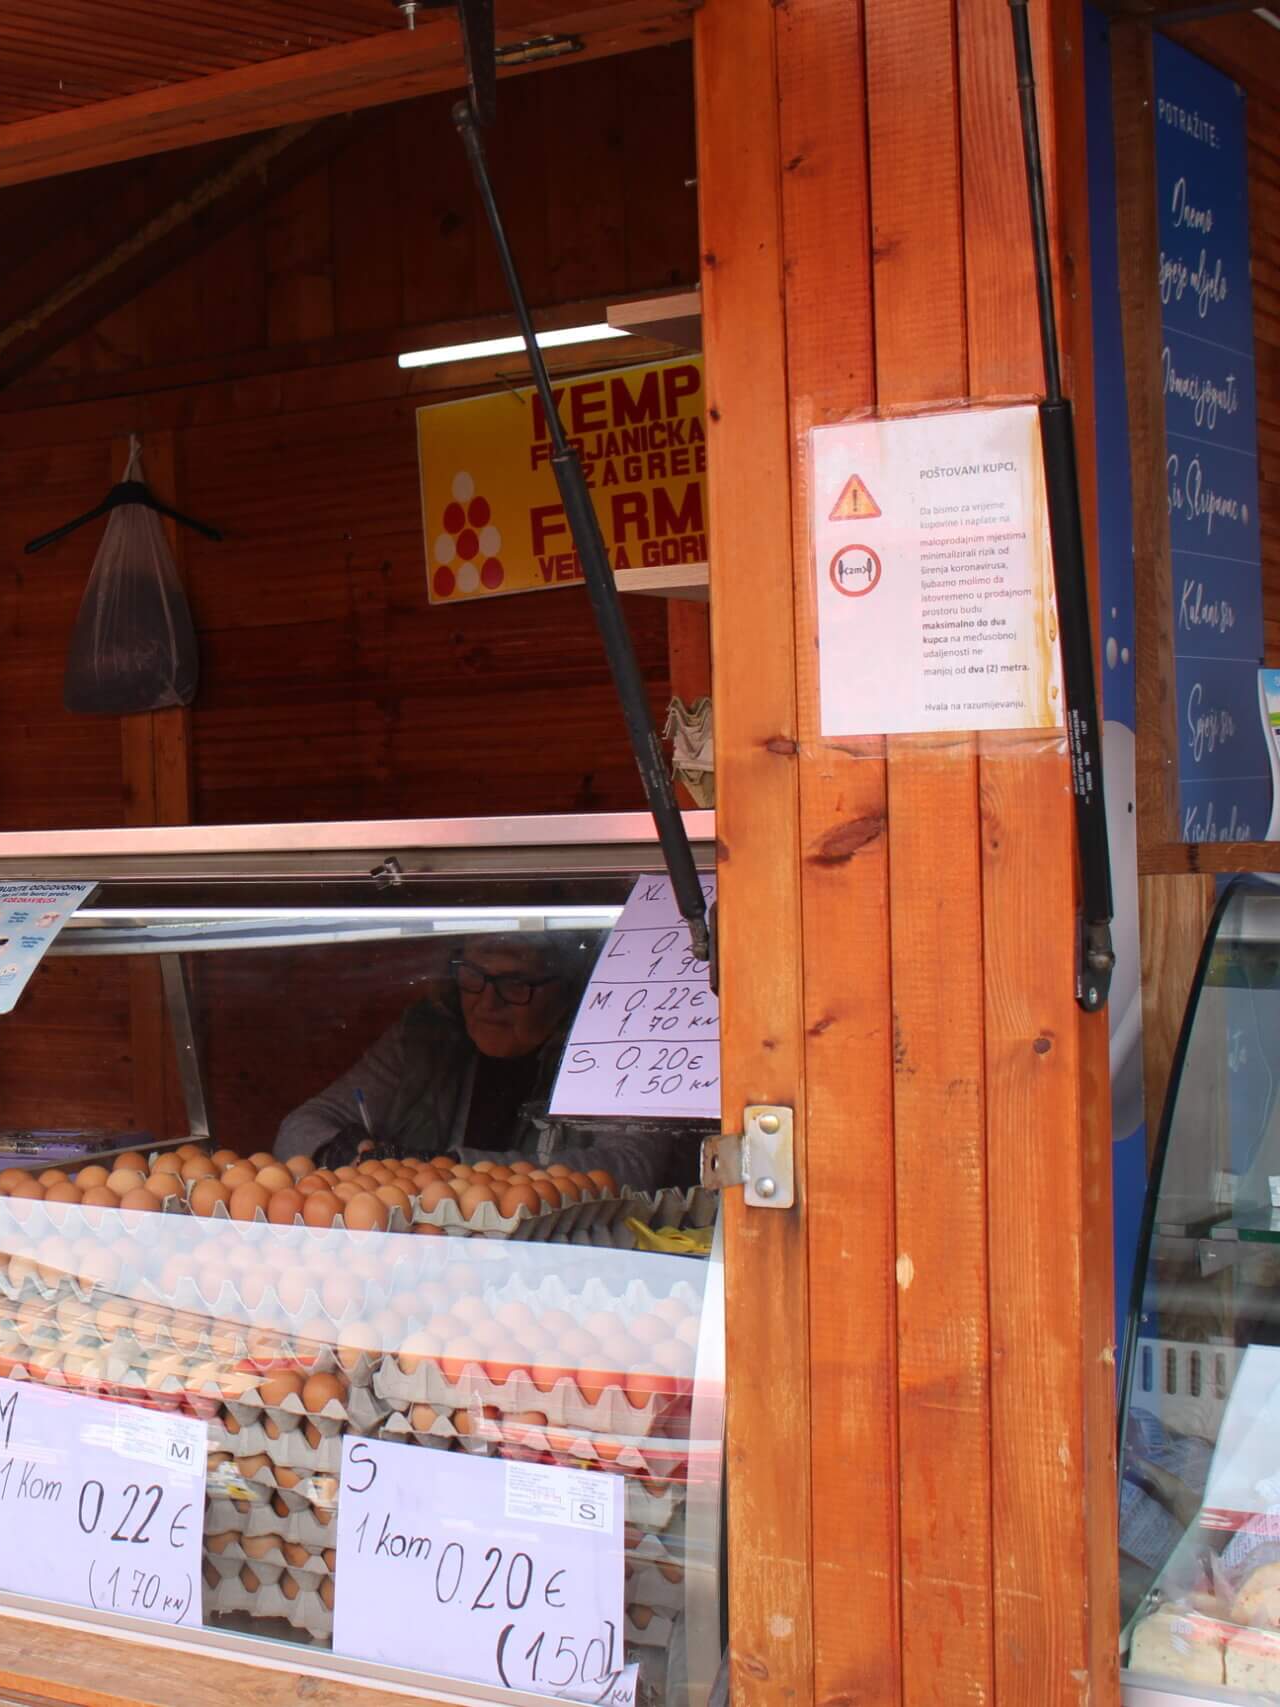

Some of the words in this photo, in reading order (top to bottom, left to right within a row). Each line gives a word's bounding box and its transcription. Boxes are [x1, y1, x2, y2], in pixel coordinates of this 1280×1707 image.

[920, 465, 980, 479] POŠTOVANI
[983, 462, 1016, 473] KUPCI,
[920, 507, 931, 515] Da
[933, 505, 959, 514] bismo
[972, 502, 1005, 512] vrijeme
[920, 520, 959, 530] kupovine
[965, 516, 997, 527] naplate
[920, 535, 984, 546] maloprodajnim
[986, 532, 1026, 543] mjestima
[920, 549, 976, 560] minimalizirali
[978, 548, 995, 556] rizik
[998, 547, 1009, 555] od
[920, 565, 948, 575] širenja
[950, 562, 1009, 572] koronavirusa,
[921, 579, 956, 590] ljubazno
[958, 576, 991, 585] molimo
[921, 592, 974, 602] istovremeno
[984, 589, 1032, 599] prodajnom
[922, 607, 958, 617] prostoru
[960, 605, 982, 614] budu
[922, 620, 975, 630] maksimalno
[976, 619, 988, 627] do
[990, 618, 1006, 626] dva
[923, 635, 948, 645] kupca
[963, 632, 1016, 642] međusobnoj
[923, 648, 970, 659] udaljenosti
[924, 667, 953, 677] manjoj
[955, 666, 966, 674] od
[968, 665, 984, 674] dva
[986, 664, 998, 675] (2)
[1000, 664, 1030, 673] metra.
[925, 702, 948, 711] Hvala
[963, 700, 1026, 711] razumijevanju.
[29, 884, 87, 892] ODGOVORNI
[170, 1443, 190, 1461] M
[346, 1443, 377, 1493] S
[0, 1457, 14, 1500] 1
[170, 1503, 193, 1548] €
[579, 1504, 596, 1520] S
[355, 1512, 369, 1554] 1
[375, 1512, 432, 1560] kom
[545, 1569, 567, 1608] €
